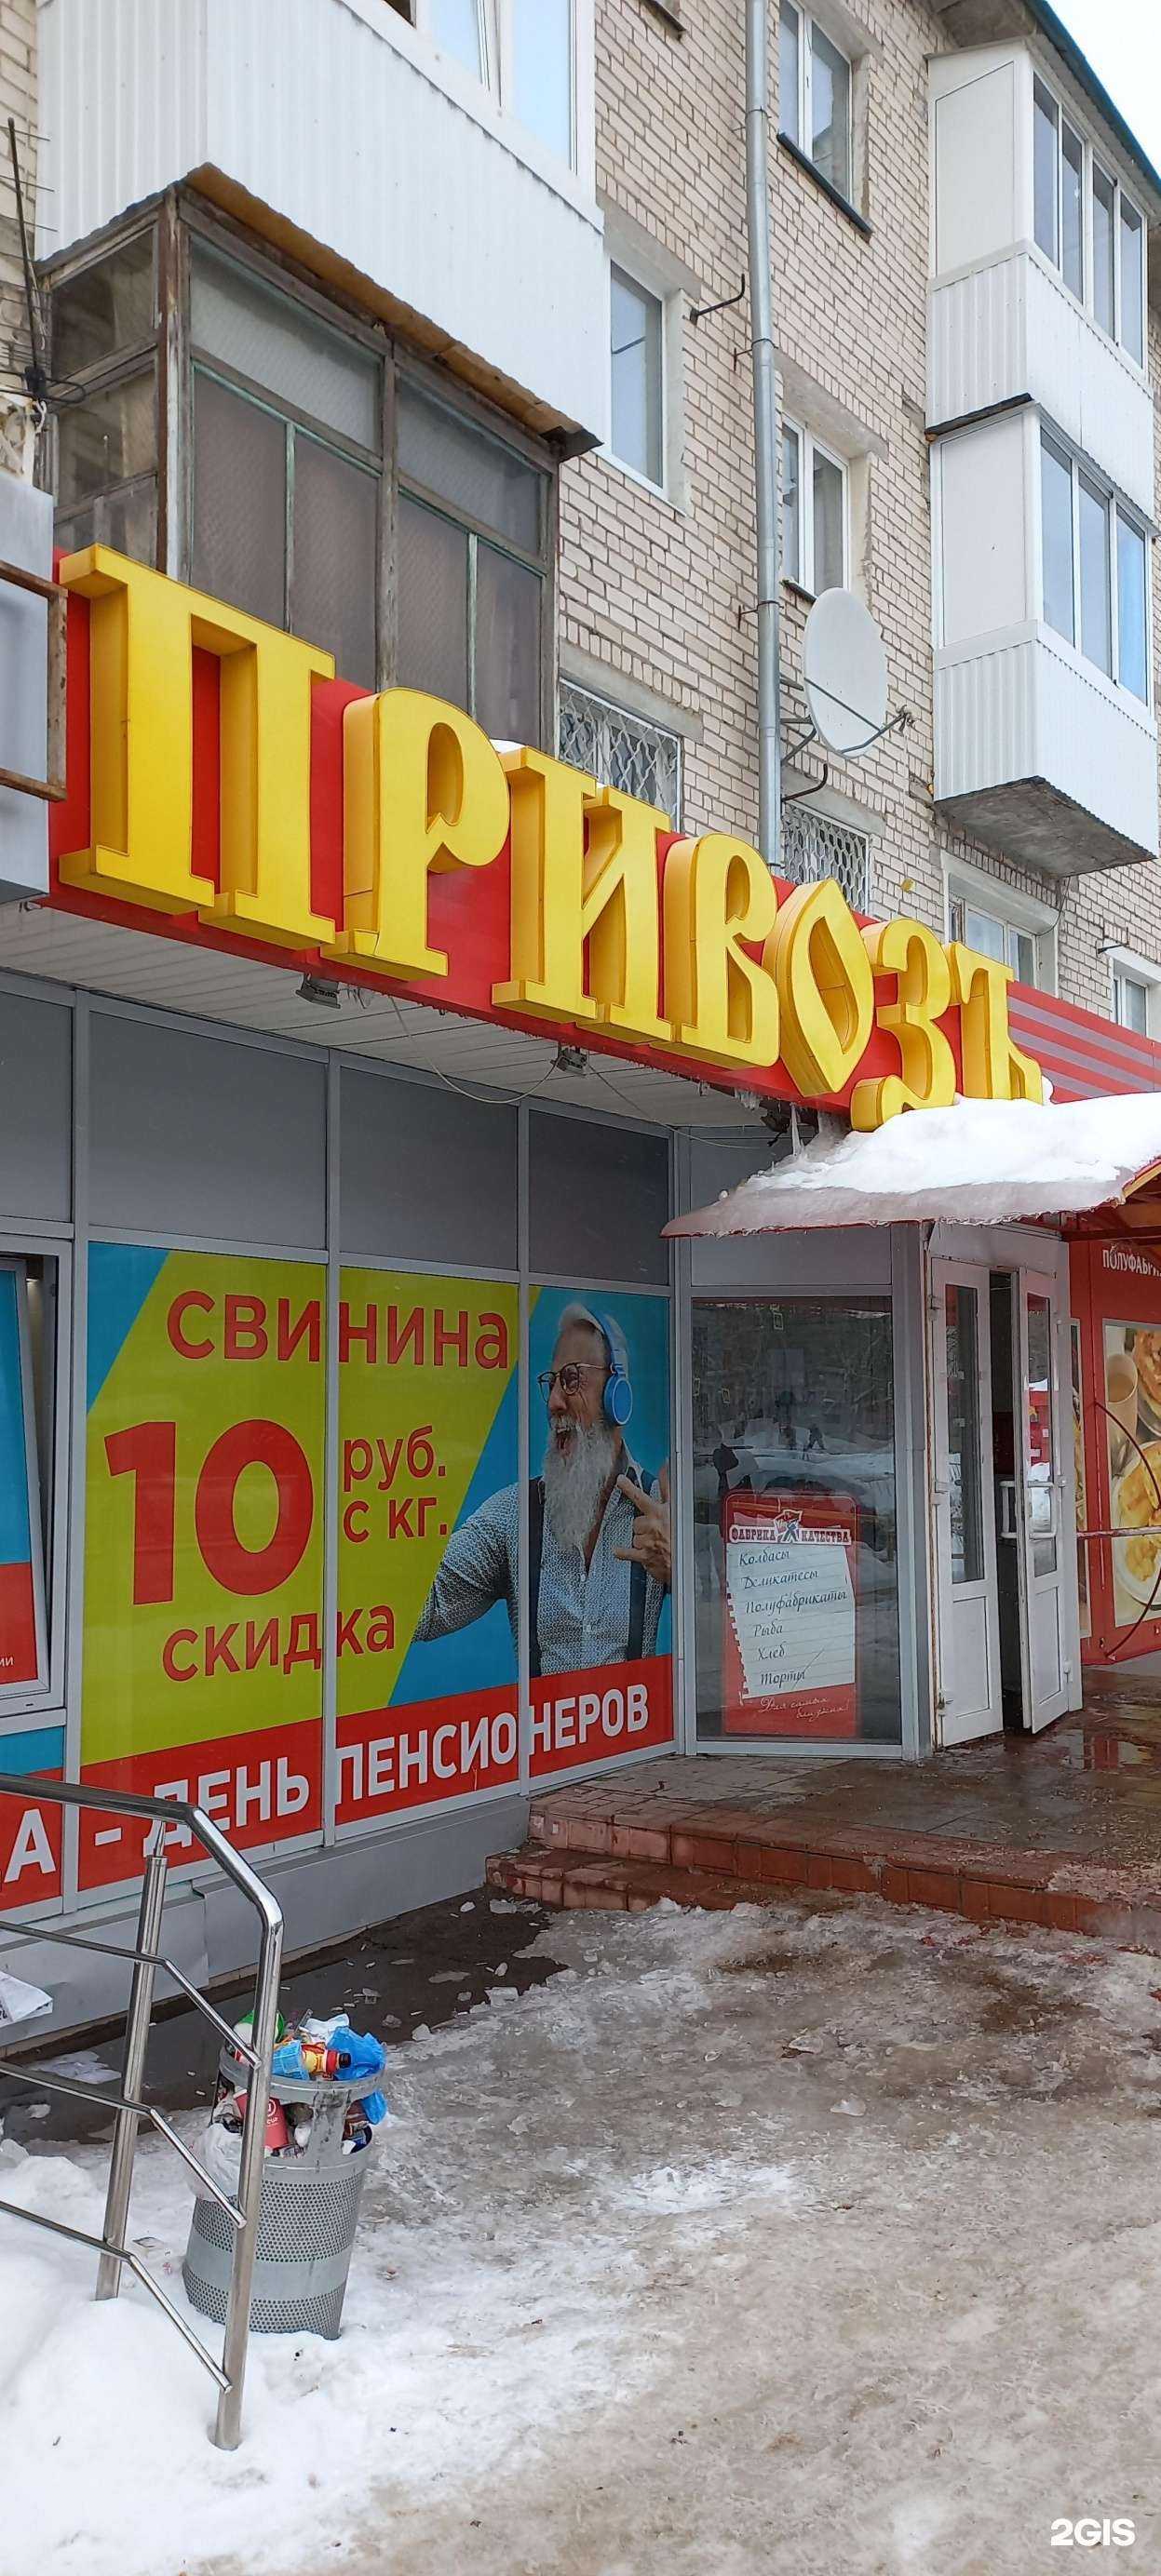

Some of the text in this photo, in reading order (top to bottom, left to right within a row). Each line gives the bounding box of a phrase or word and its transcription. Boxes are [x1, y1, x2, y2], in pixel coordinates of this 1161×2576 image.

[59, 543, 1043, 1132] ПРИВОЗЪ
[343, 1425, 447, 1492] руб.
[103, 1419, 314, 1606] 10
[343, 1496, 449, 1543] с кг.
[730, 1527, 850, 1543] ФАБРИКА КАЧЕСТВА
[739, 1546, 790, 1566] Колбасы
[742, 1569, 818, 1590] Деликатесы
[745, 1590, 848, 1617] Полуфабрикаты
[753, 1618, 783, 1637] Рыба
[757, 1641, 788, 1661] Хлеб
[761, 1670, 805, 1688] Торты
[142, 1756, 310, 1858] ДЕНЬ
[334, 1683, 650, 1806] ПЕНСИОНЕРОВ
